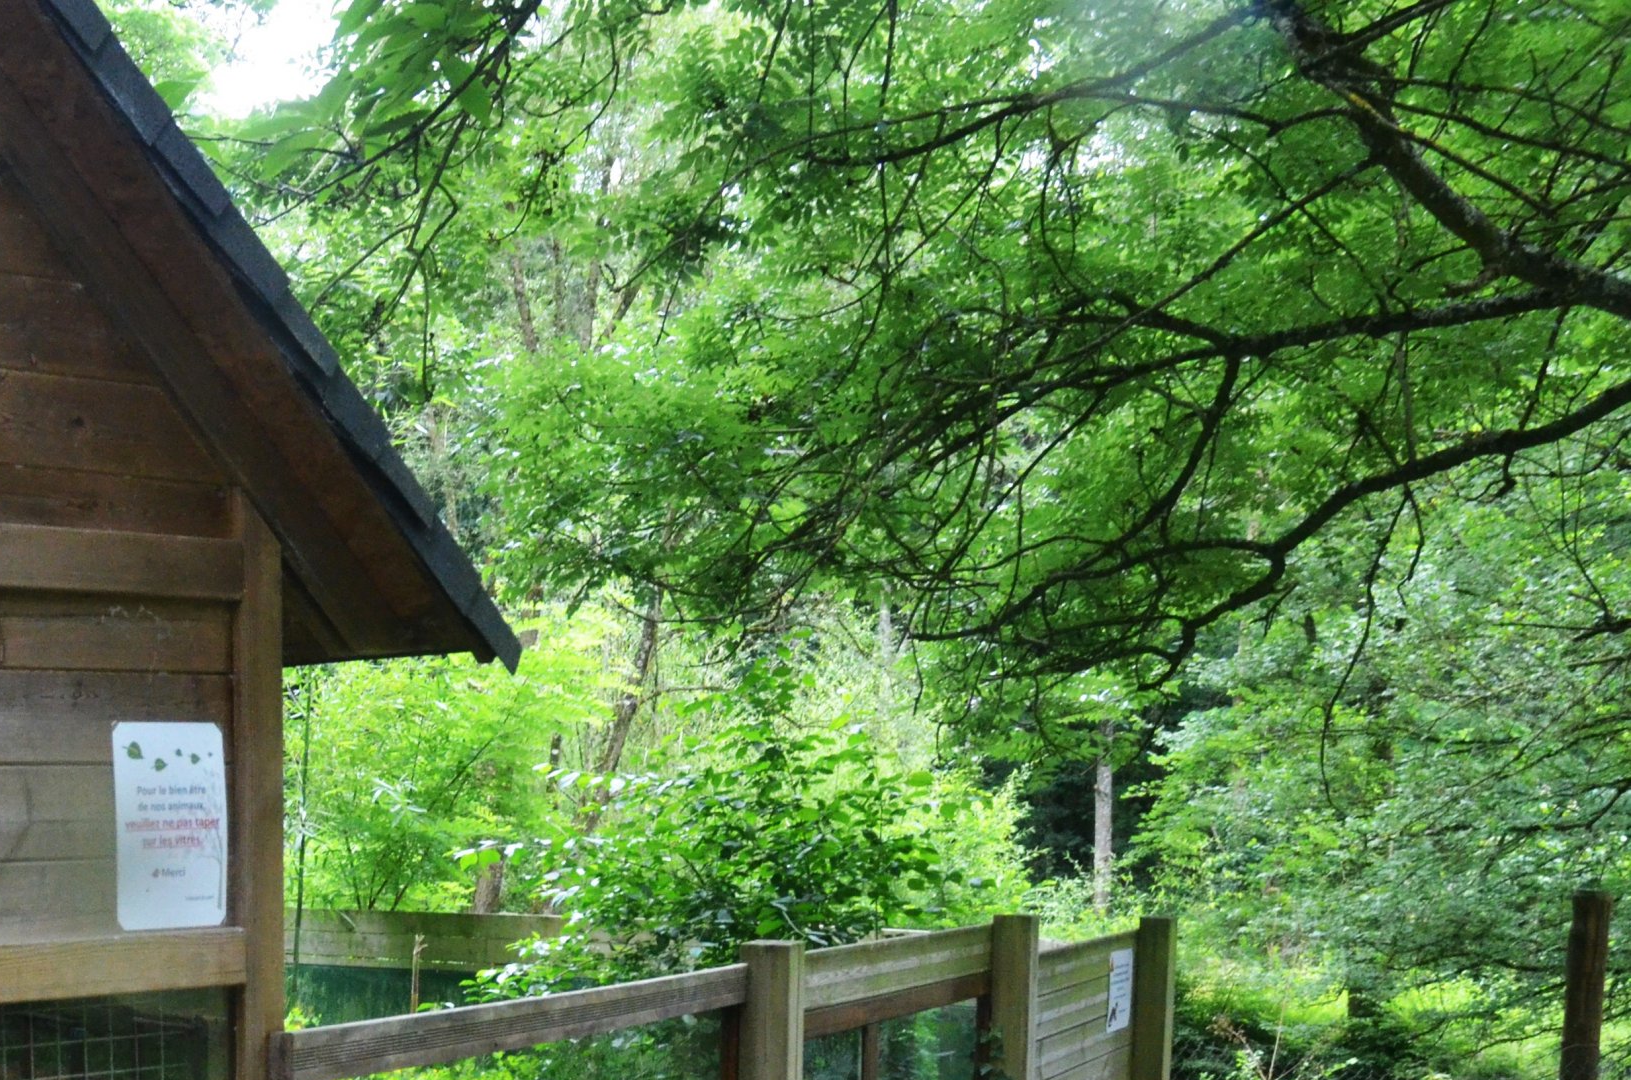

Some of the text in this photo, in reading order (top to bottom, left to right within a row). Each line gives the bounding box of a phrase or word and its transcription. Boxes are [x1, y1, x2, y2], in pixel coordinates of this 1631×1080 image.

[137, 785, 157, 796] Pour
[169, 784, 188, 795] bien
[195, 817, 219, 829] taper
